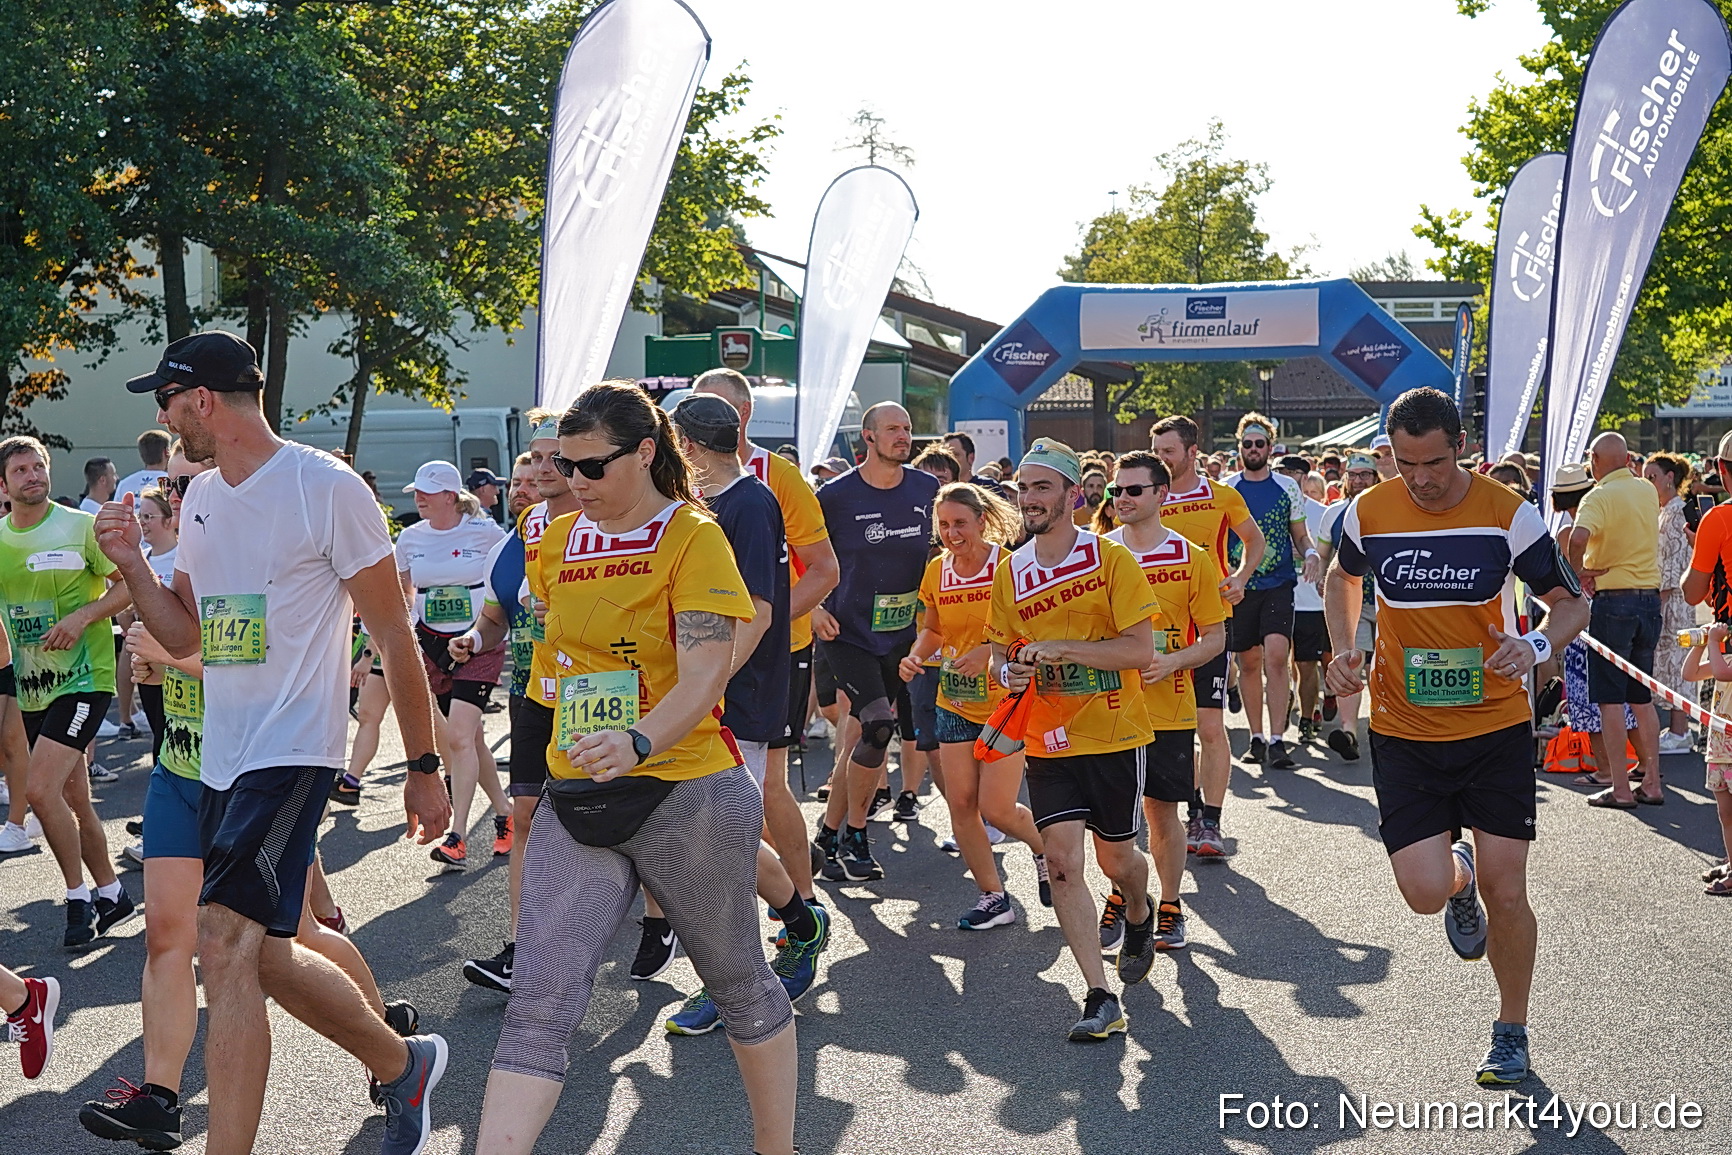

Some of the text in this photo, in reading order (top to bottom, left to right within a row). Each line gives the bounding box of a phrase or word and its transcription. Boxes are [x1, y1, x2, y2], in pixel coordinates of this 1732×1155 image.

[1610, 28, 1687, 187] Fischer
[1642, 50, 1700, 179] AUTOMOBILE
[1172, 319, 1260, 337] firmenlauf
[1002, 350, 1050, 361] Fischer
[168, 360, 193, 373] MAX BÖGL
[1183, 502, 1216, 513] BÖGL
[886, 524, 922, 537] Firmenlauf
[558, 559, 653, 584] MAX BÖGL
[1147, 569, 1191, 585] BÖGL
[1396, 564, 1480, 580] Fischer
[1404, 582, 1474, 590] AUTOMOBILE
[431, 598, 463, 612] 1519
[938, 594, 963, 606] MAX
[1018, 574, 1106, 622] MAX BÖGL
[882, 605, 912, 619] 1768
[16, 617, 42, 633] 204
[209, 618, 250, 642] 1147
[252, 622, 260, 654] 2022
[220, 644, 242, 653] Jürgen
[1045, 663, 1080, 681] 812
[1086, 665, 1097, 687] 202
[1418, 668, 1471, 688] 1869
[946, 673, 977, 688] 1649
[1472, 670, 1480, 696] 2022
[189, 685, 197, 713] 2022
[568, 697, 623, 724] 1148
[566, 722, 626, 736] Nehring Stefanie
